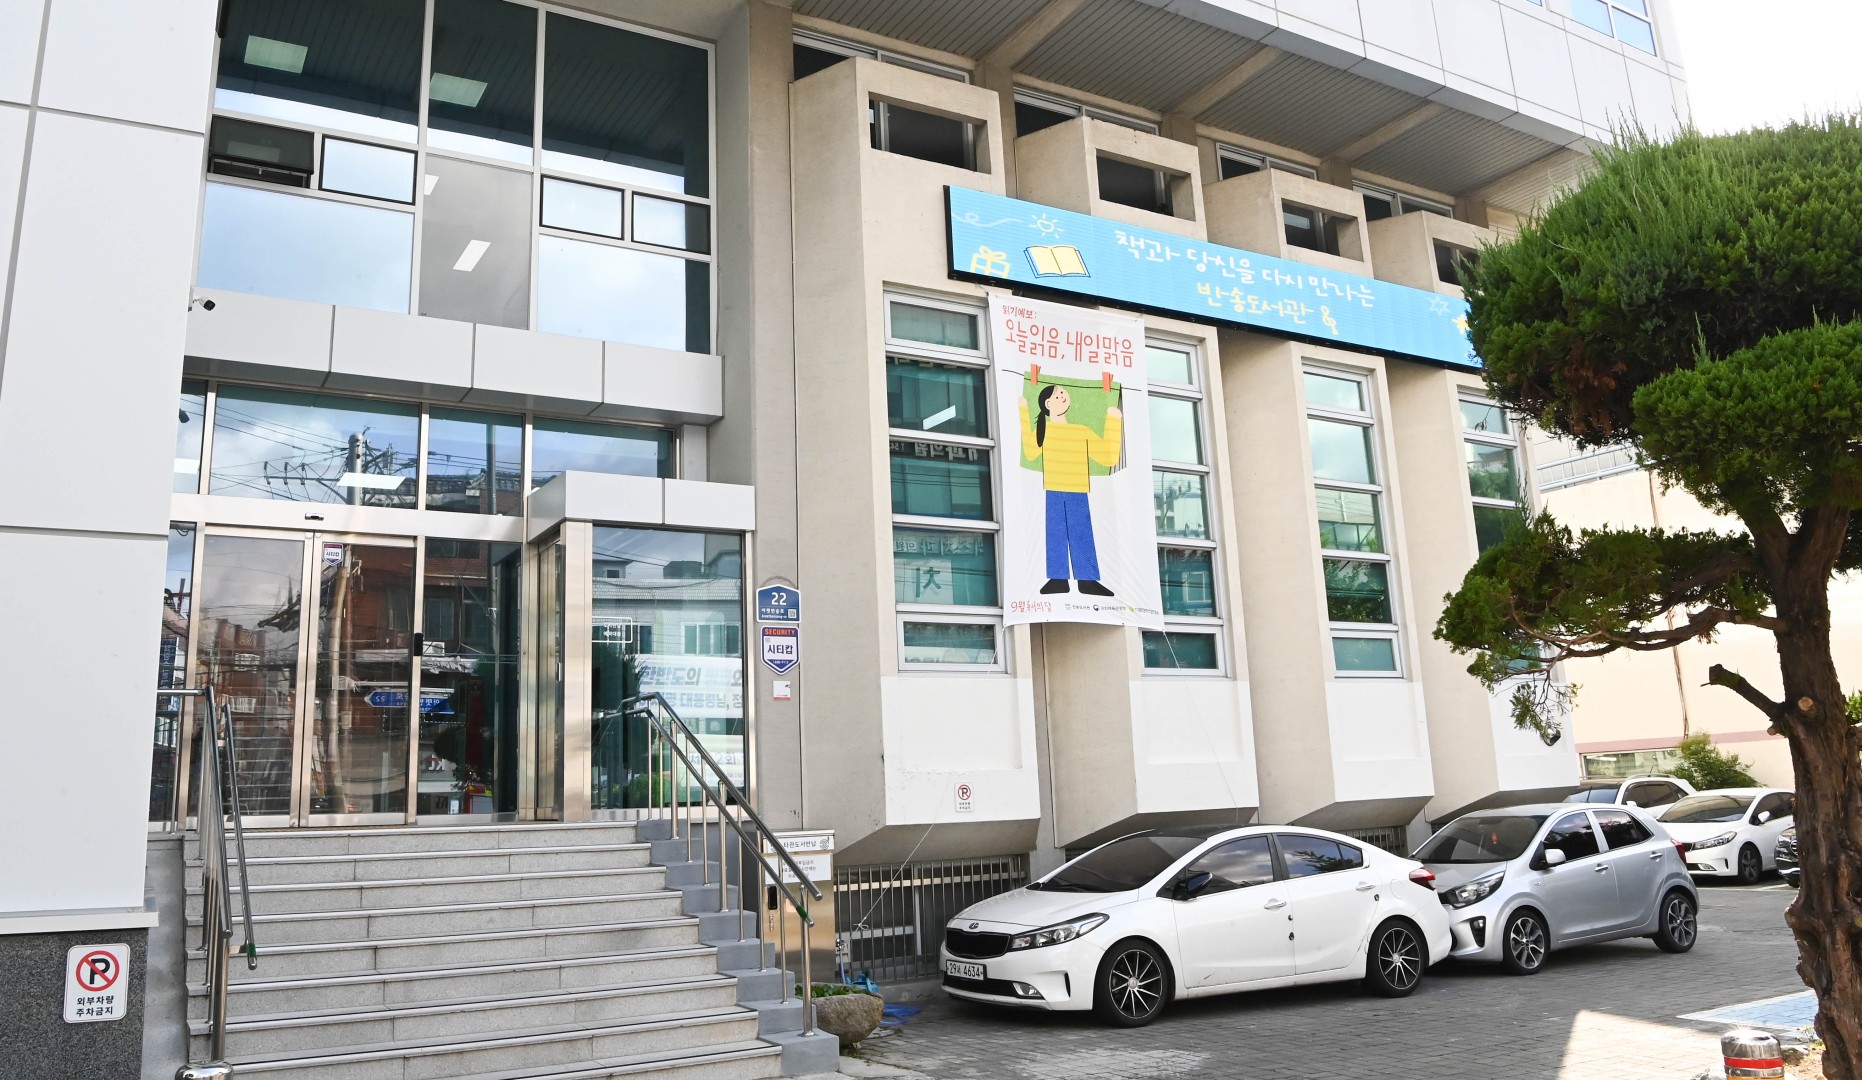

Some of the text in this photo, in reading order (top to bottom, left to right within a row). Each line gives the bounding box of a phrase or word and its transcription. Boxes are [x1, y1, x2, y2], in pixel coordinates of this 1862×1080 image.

[1114, 230, 1375, 307] 책과 당신을 다시 만나는
[1197, 282, 1314, 324] 반송도서관
[771, 592, 787, 606] 22
[764, 628, 796, 636] SECURITY
[767, 644, 794, 655] 시티캅
[963, 965, 980, 978] 4634
[77, 995, 114, 1006] 외부차량
[76, 1006, 114, 1017] 주차금지
